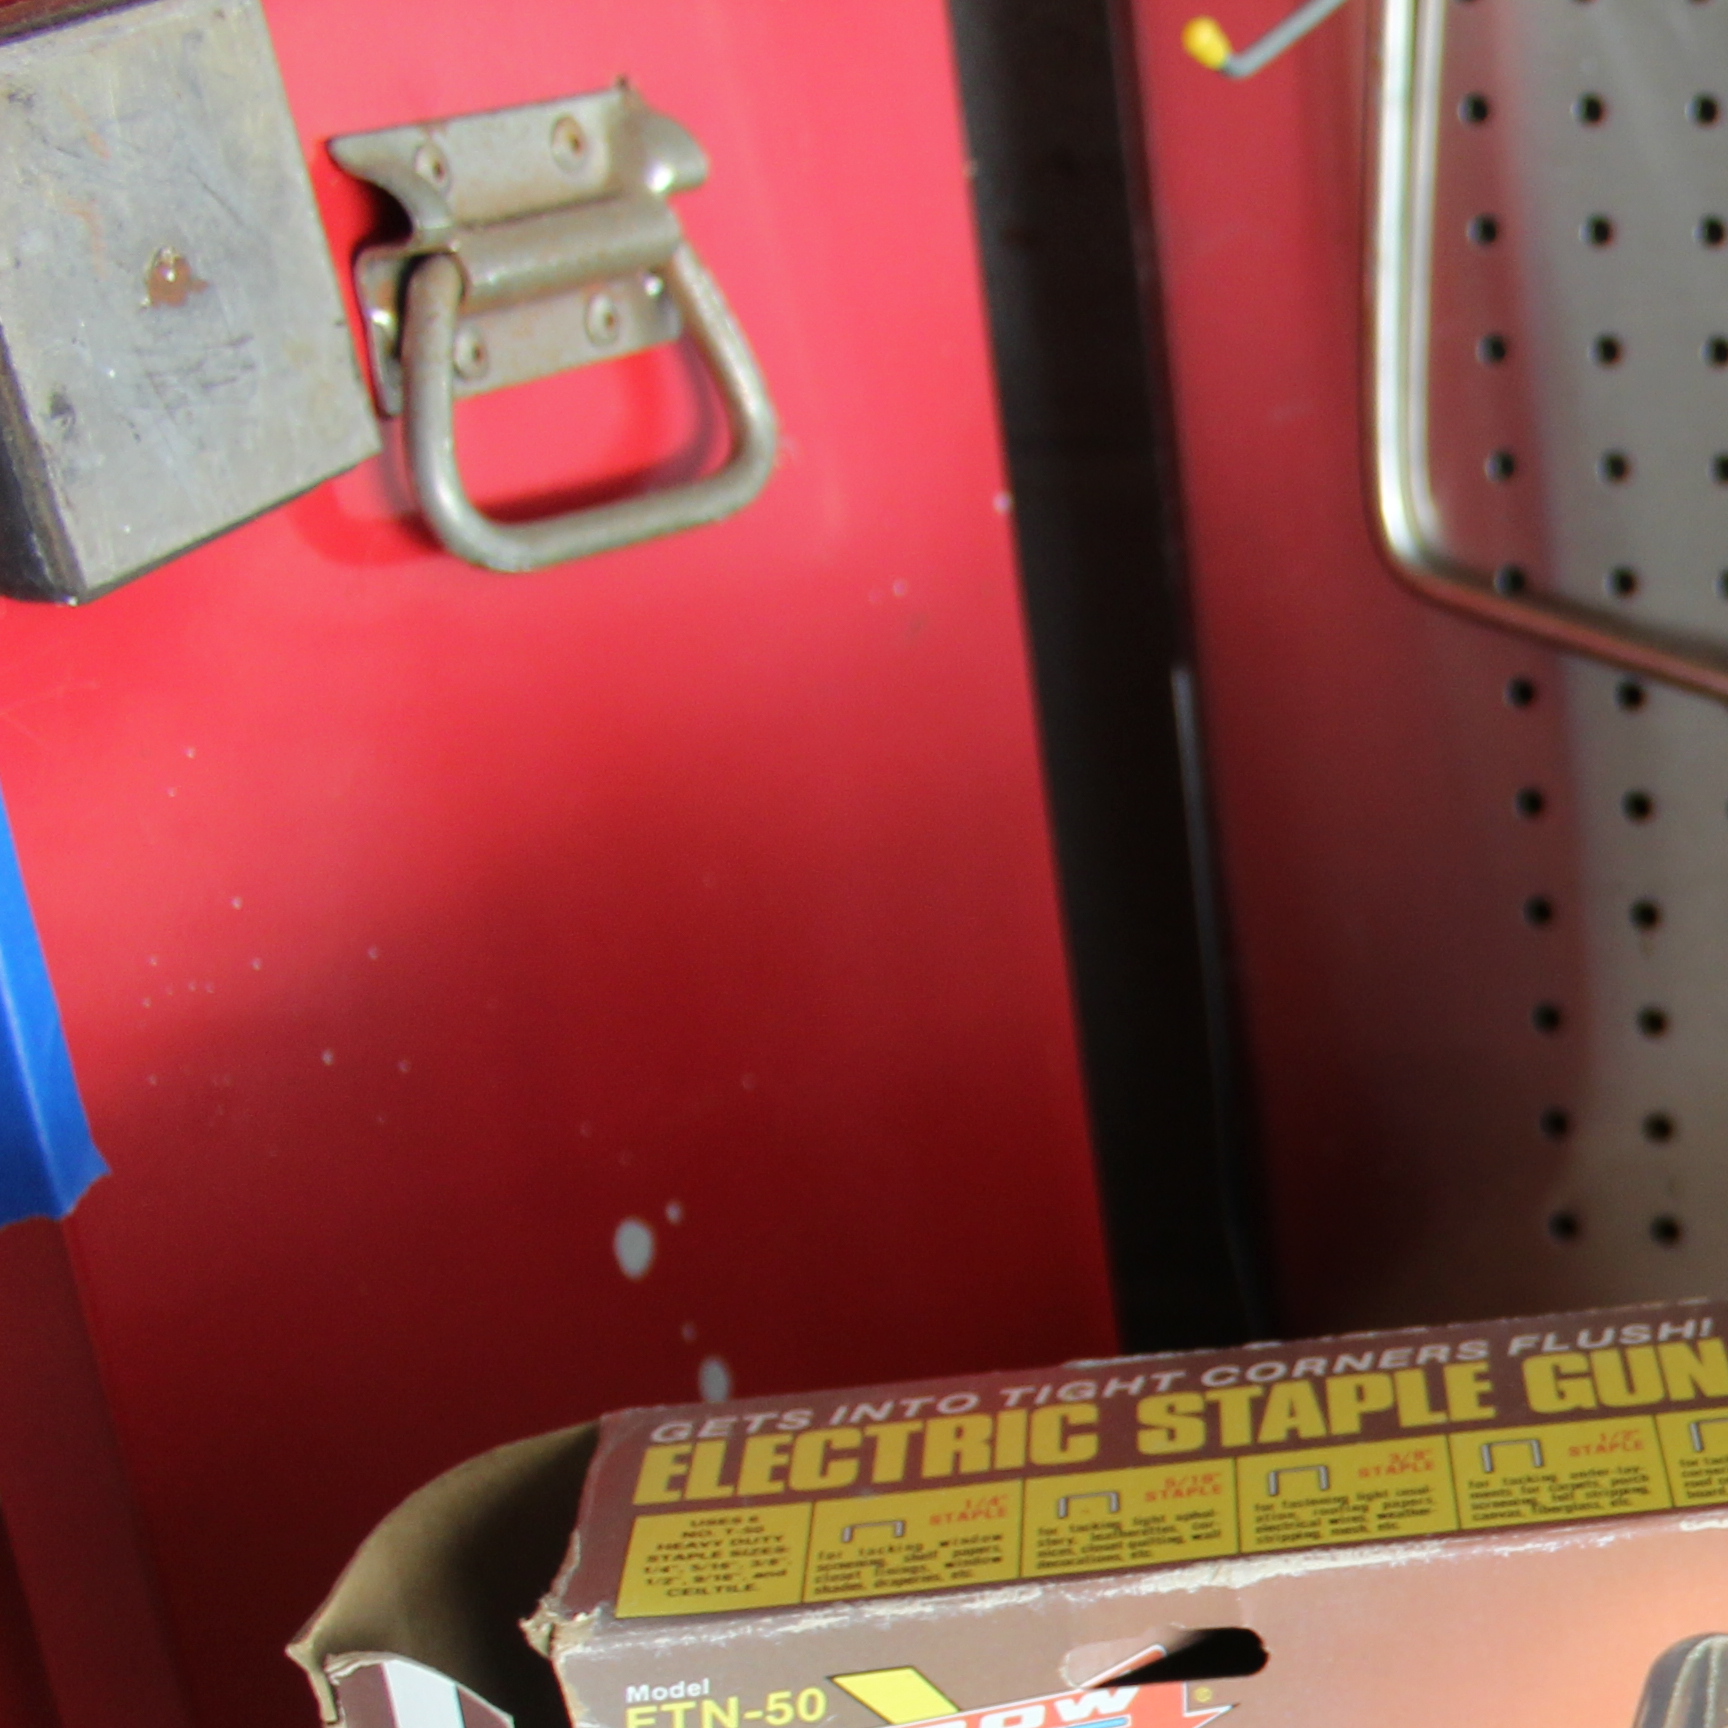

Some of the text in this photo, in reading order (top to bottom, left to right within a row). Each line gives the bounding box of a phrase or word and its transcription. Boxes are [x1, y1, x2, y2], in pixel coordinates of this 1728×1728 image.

[634, 1402, 1100, 1505] ELECTRIC
[1137, 1364, 1497, 1455] STAPLE
[650, 1317, 1717, 1444] GETS INTO TIGHT CORNERS FLUSH!
[626, 1677, 712, 1703] Model
